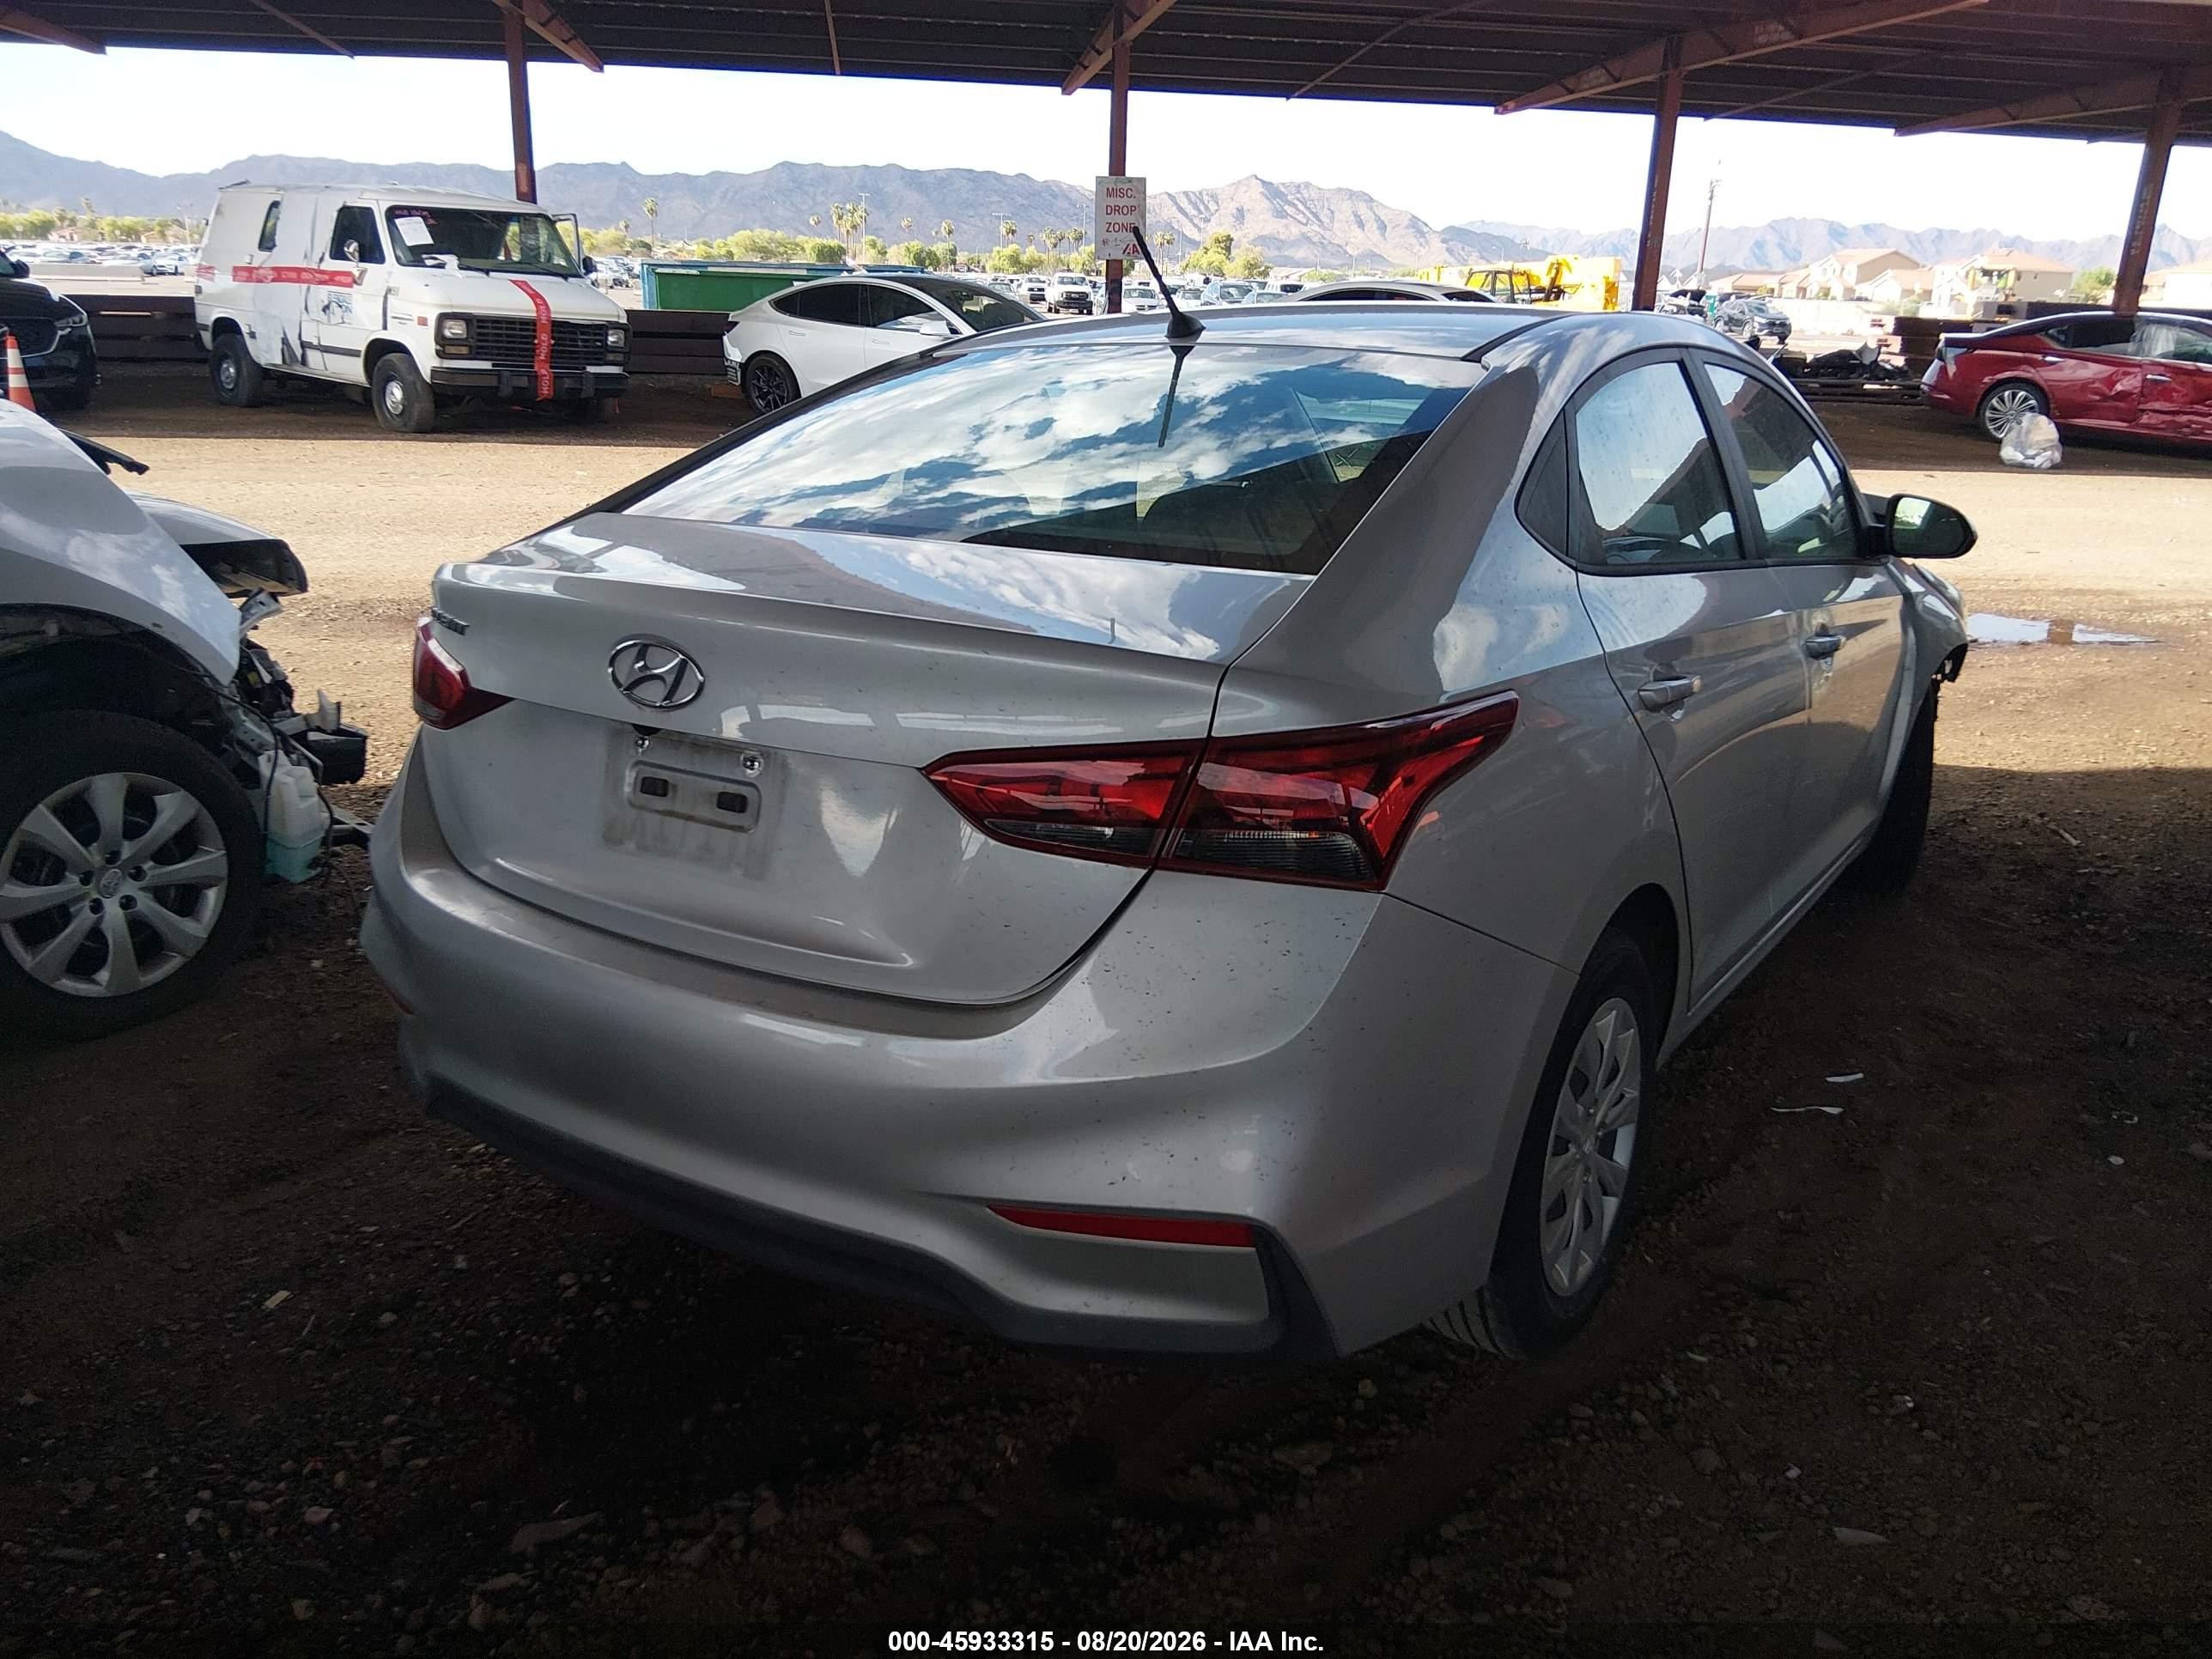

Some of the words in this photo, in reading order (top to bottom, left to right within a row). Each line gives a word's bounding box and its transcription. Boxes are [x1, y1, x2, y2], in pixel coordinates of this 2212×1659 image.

[1106, 187, 1135, 198] MISC.
[1106, 204, 1136, 216] DROP
[1106, 222, 1135, 233] ZONE
